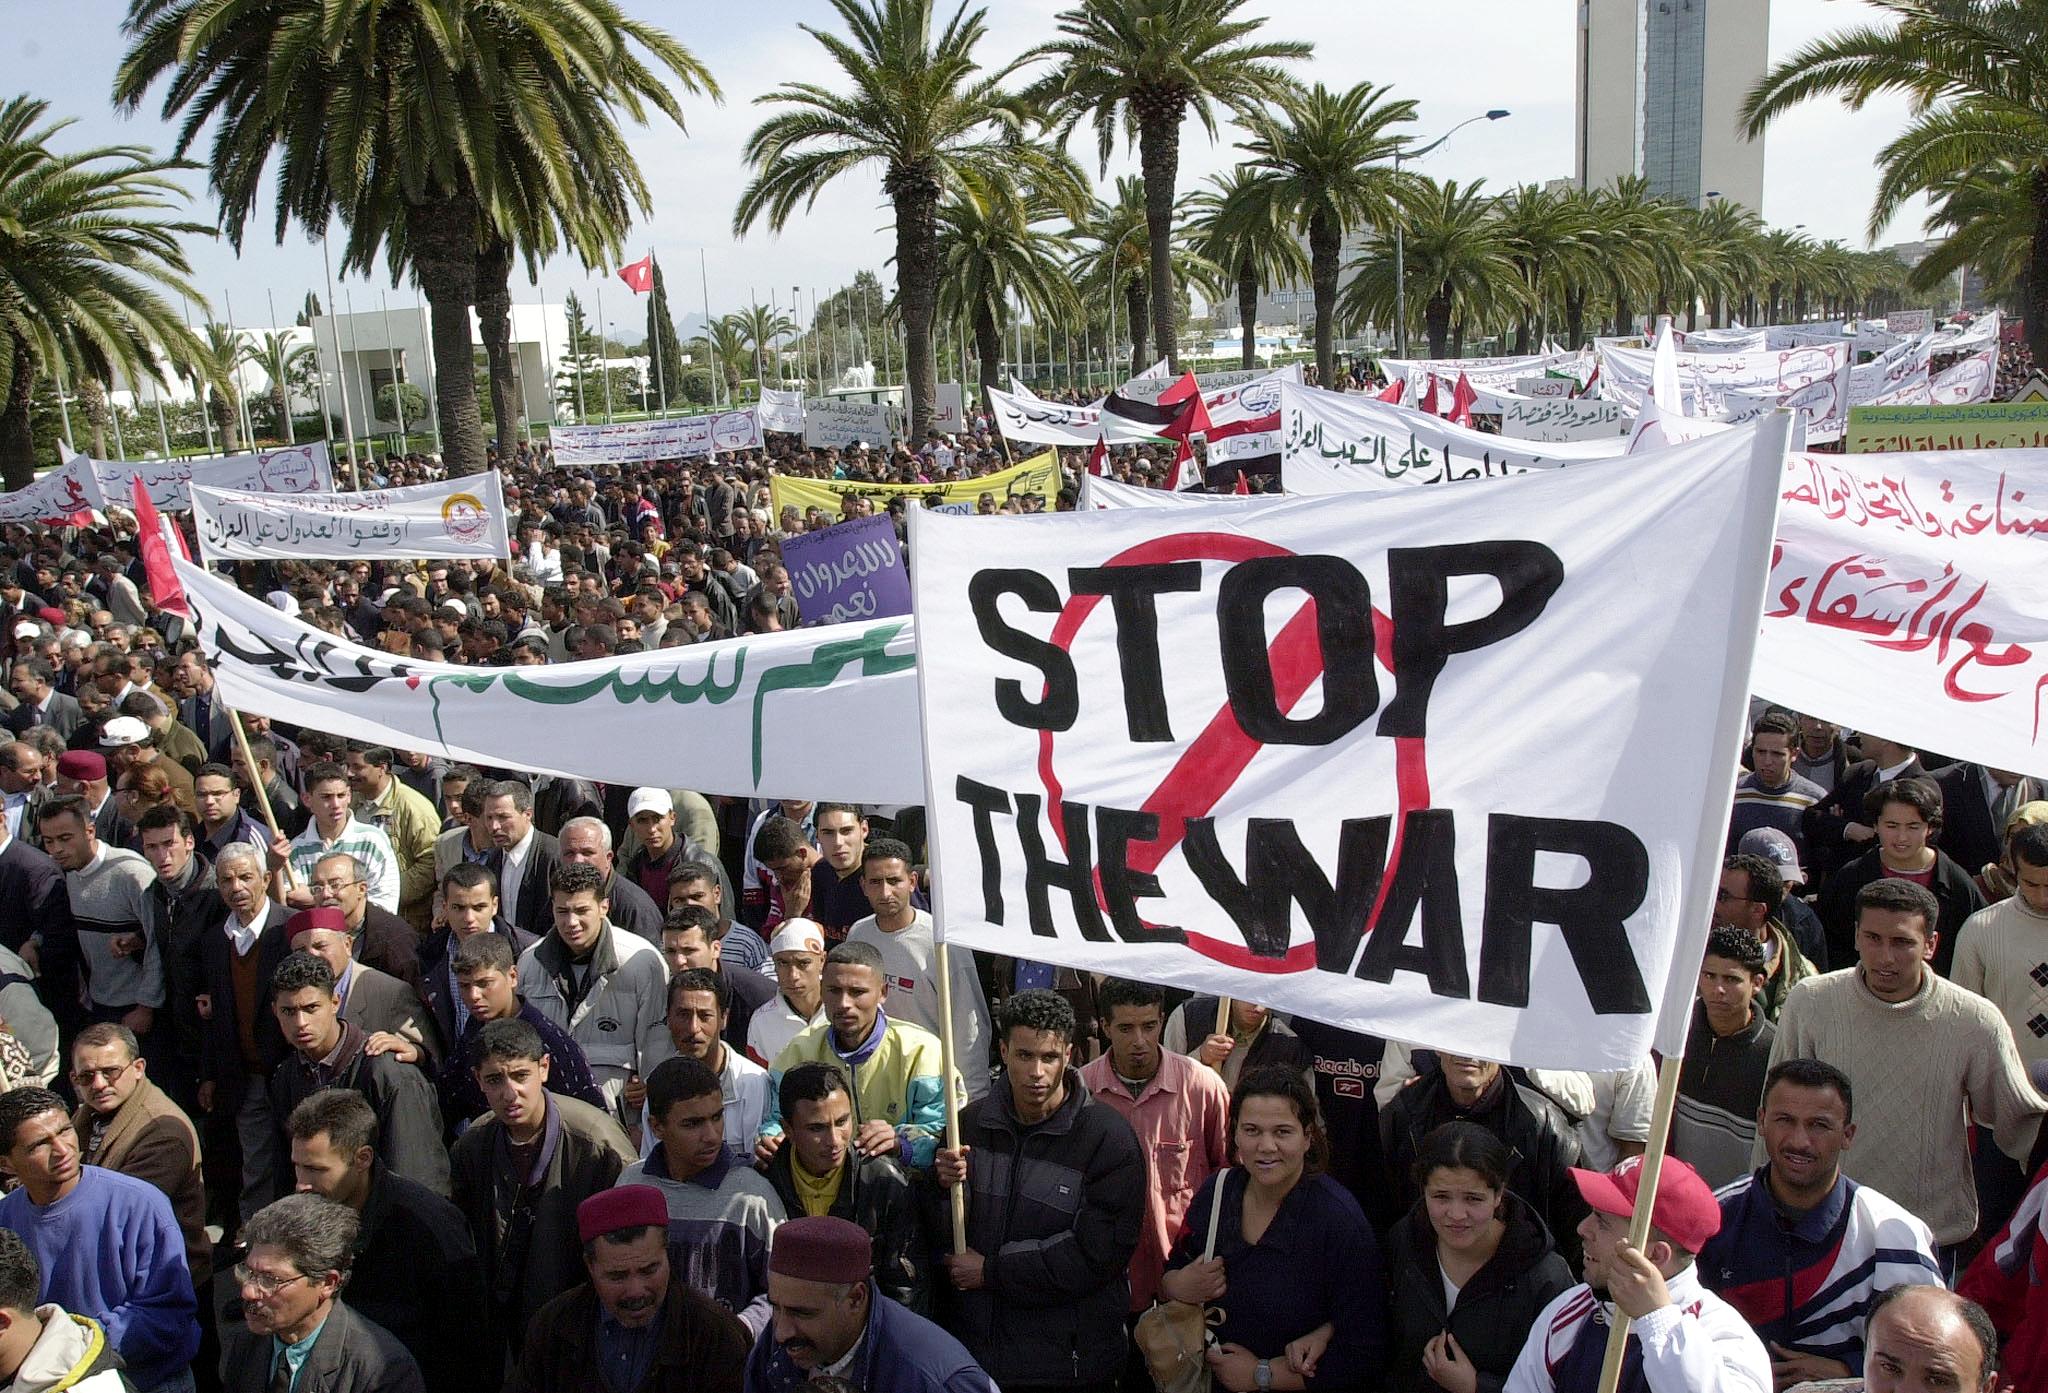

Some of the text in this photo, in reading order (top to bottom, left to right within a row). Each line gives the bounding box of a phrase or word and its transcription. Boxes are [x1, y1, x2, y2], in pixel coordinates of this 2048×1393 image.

[1322, 433, 1386, 470] الشعب
[1384, 432, 1433, 478] على
[205, 512, 250, 550] العراق
[249, 511, 274, 547] على
[968, 540, 1564, 745] STOP
[955, 774, 1652, 1015] THE WAR
